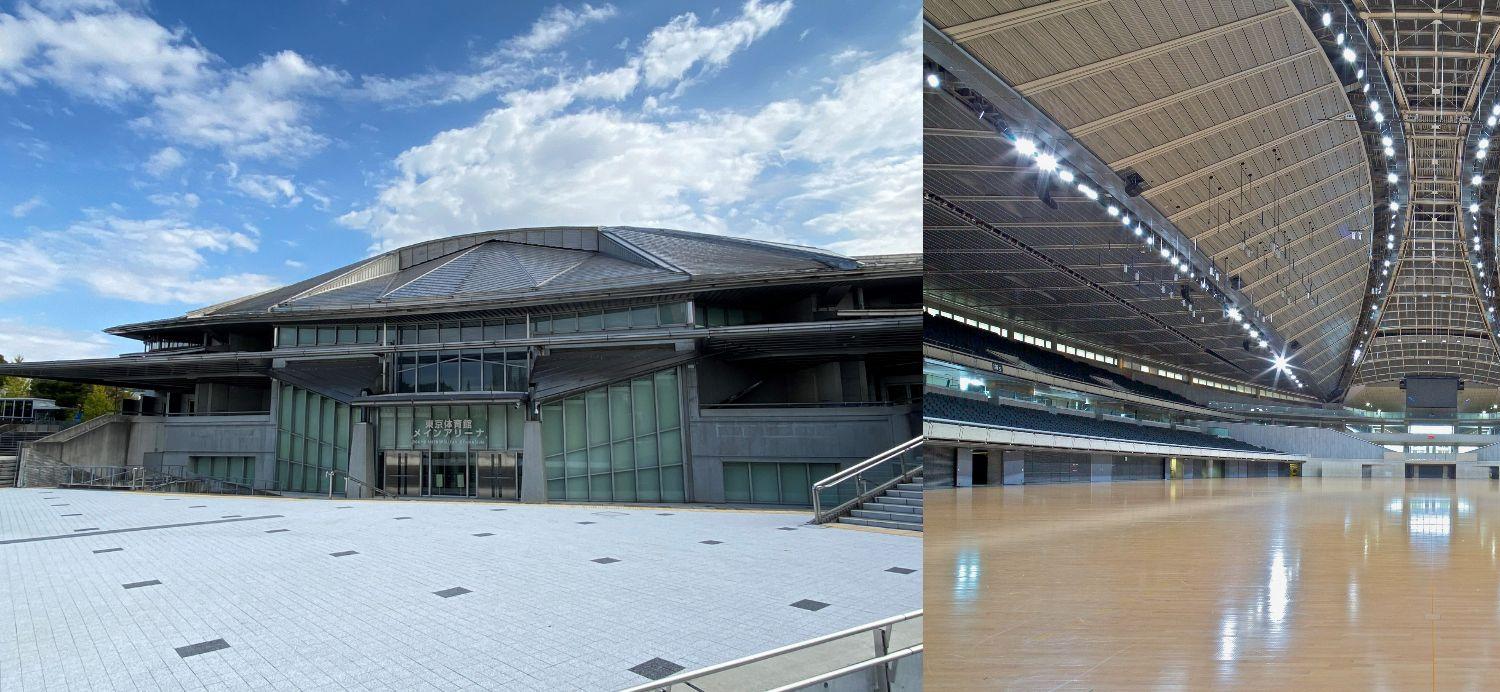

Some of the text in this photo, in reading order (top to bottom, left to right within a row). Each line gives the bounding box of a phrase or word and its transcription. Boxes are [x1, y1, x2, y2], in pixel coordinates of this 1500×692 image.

[425, 419, 472, 429] 東京体育館
[413, 428, 485, 438] メインアリーナ
